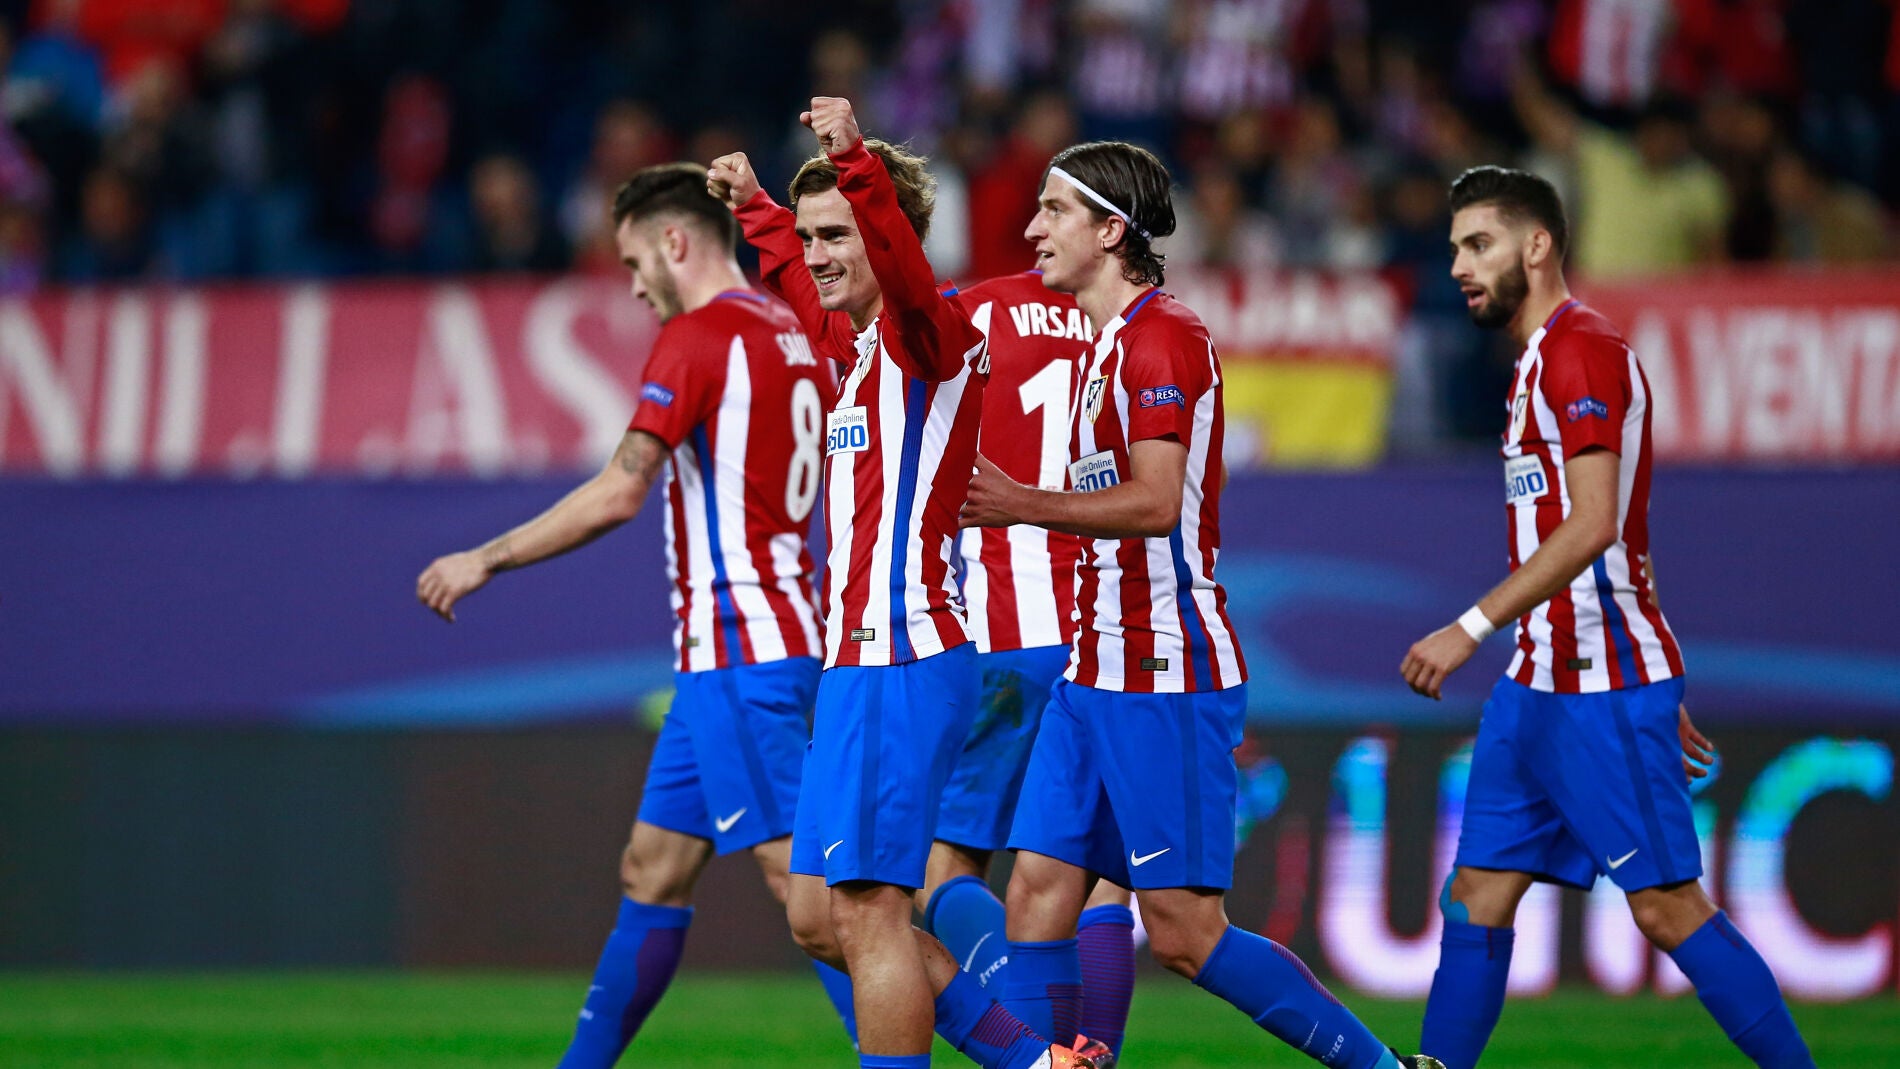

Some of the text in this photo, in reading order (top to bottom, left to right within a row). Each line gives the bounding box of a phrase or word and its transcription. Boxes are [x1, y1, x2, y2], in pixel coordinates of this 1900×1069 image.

[843, 413, 864, 424] Online
[784, 377, 822, 522] 8
[1088, 459, 1113, 471] Online
